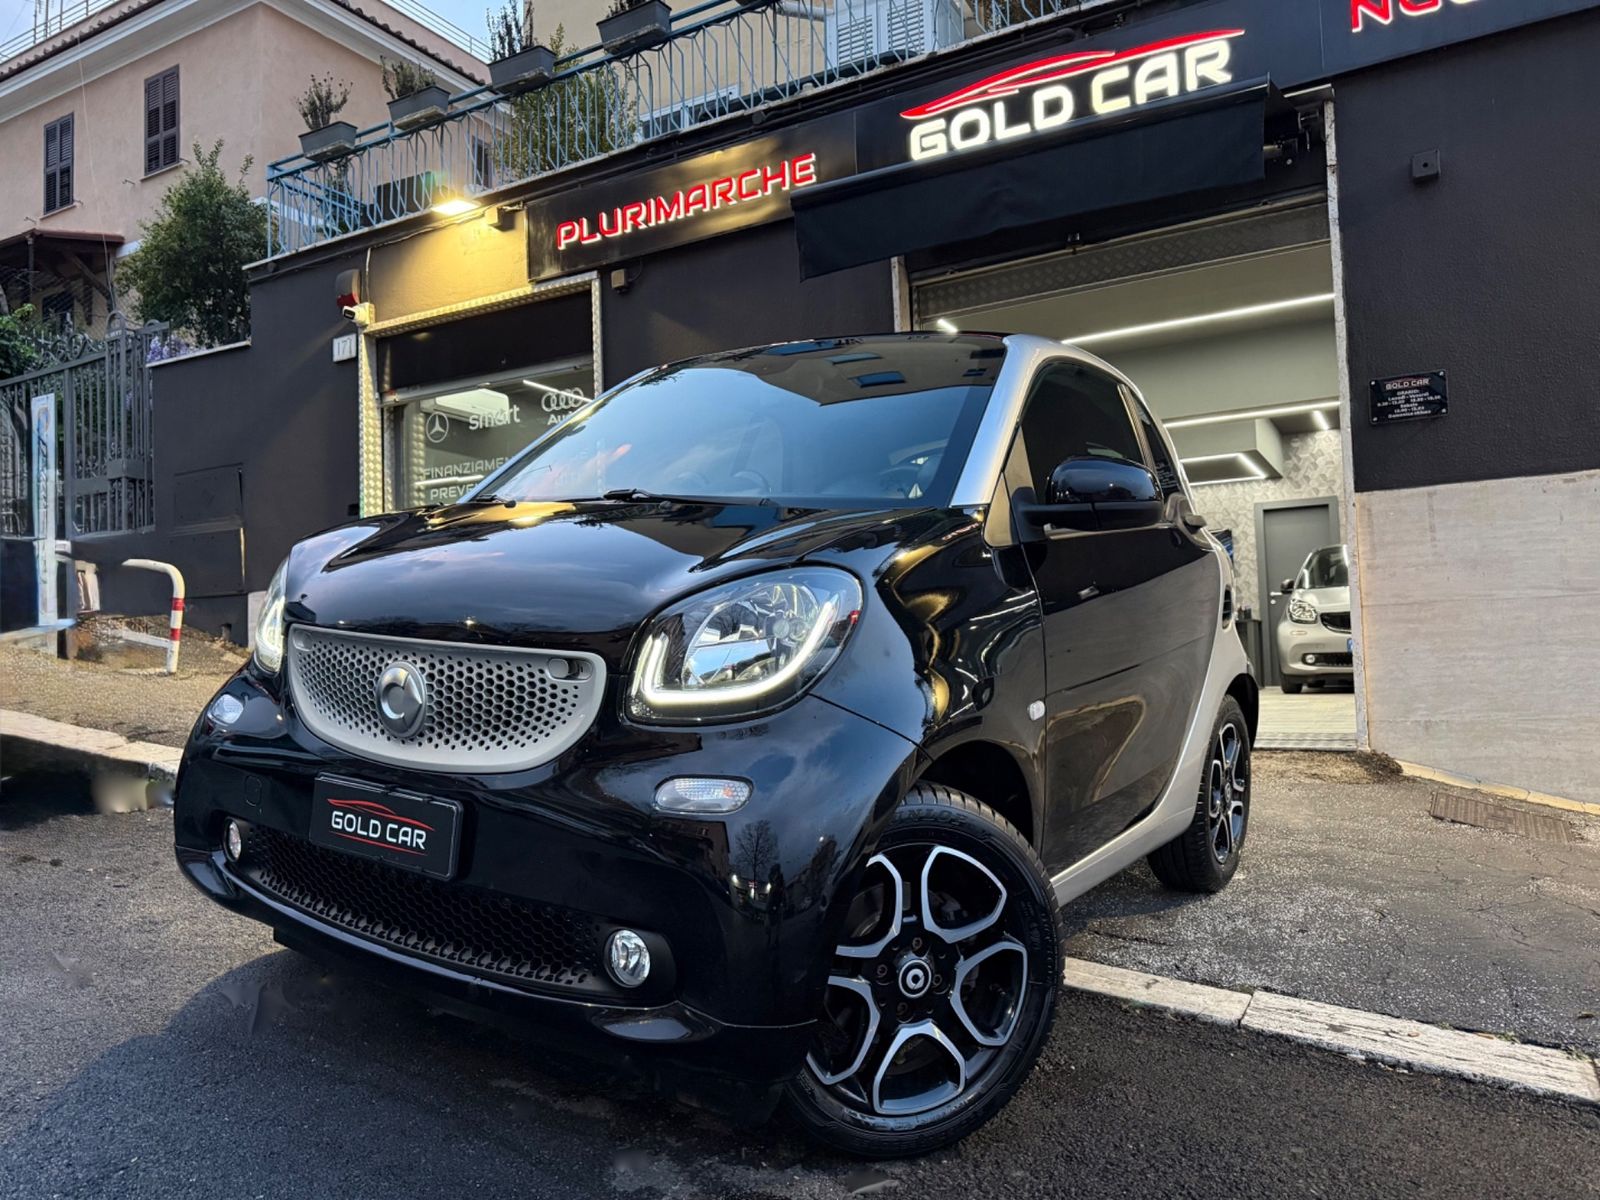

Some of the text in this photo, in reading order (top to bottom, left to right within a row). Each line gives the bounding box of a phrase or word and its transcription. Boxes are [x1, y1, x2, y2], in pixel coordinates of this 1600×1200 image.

[909, 39, 1233, 162] GOLD CAR
[557, 152, 817, 250] PLURIMARCHE
[469, 404, 521, 431] smart
[423, 456, 510, 479] FINANZIAME
[430, 482, 478, 501] PREVE
[331, 810, 427, 850] GOLD CAR
